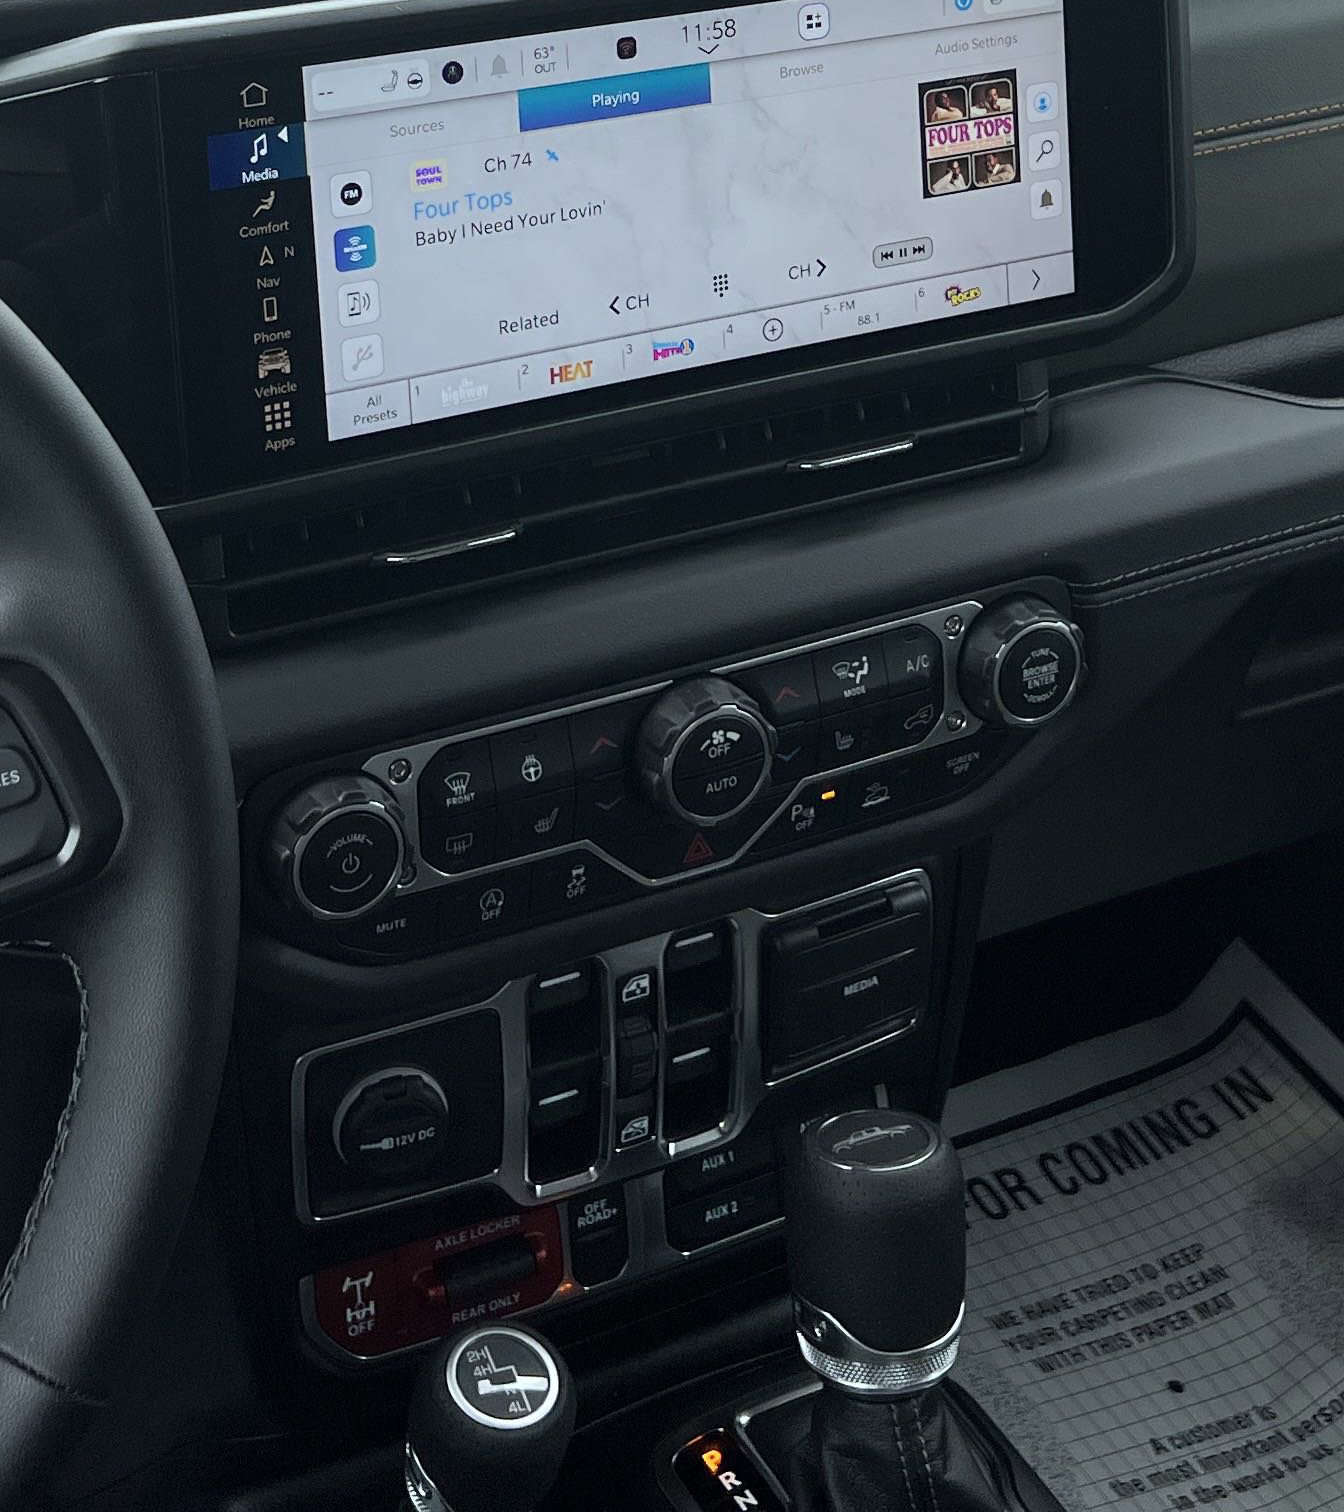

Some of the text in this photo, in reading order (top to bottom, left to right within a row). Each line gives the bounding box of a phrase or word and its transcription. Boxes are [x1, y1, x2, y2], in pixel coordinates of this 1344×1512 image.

[681, 18, 737, 43] 11:58
[533, 46, 556, 61] 63°
[935, 32, 1018, 57] Audio Settings
[534, 61, 557, 74] OUT
[779, 61, 825, 79] Browse
[591, 89, 640, 109] Playing
[238, 113, 276, 130] Home
[389, 119, 445, 138] Sources
[927, 115, 1013, 147] FOUR TOPS
[415, 165, 443, 177] SOUL
[484, 152, 532, 174] Ch 74
[242, 167, 279, 184] Media
[416, 174, 443, 186] TOWN
[413, 189, 513, 221] Four Tops
[239, 219, 291, 238] Comfort
[415, 200, 608, 247] Baby Need Your Lovin'
[788, 264, 811, 281] CH
[256, 275, 281, 290] Nav
[626, 294, 650, 311] CH
[839, 300, 856, 313] FM
[498, 310, 561, 335] Related
[857, 313, 881, 327] 88.1
[254, 327, 292, 344] Phone
[550, 360, 594, 384] HEAT
[255, 380, 298, 399] Vehicle
[366, 394, 382, 409] All
[353, 407, 398, 427] Presets
[265, 435, 296, 453] Apps
[906, 653, 930, 674] A/C
[1022, 661, 1059, 679] BROWSE
[1027, 673, 1056, 689] ENTER
[843, 685, 867, 699] MODE
[708, 742, 731, 759] OFF
[946, 750, 980, 769] SCREEN
[953, 762, 971, 776] OFF
[705, 775, 738, 794] AUTO
[446, 791, 475, 807] FRONT
[795, 816, 814, 831] OFF
[330, 833, 368, 853] VOLUME
[566, 885, 587, 899] OFF
[481, 908, 502, 921] OFF
[376, 918, 408, 935] MUTE
[843, 976, 879, 996] MEDIA
[394, 1126, 435, 1148] 12V DC
[1037, 1065, 1274, 1196] COMING IN
[701, 1154, 724, 1172] AUX
[584, 1199, 607, 1215] OFF
[705, 1205, 728, 1223] AUX
[434, 1215, 520, 1250] AXLE LOCKER
[1130, 1263, 1159, 1285] TO
[1159, 1243, 1206, 1273] KEEP
[1164, 1264, 1231, 1300] CLEAN
[452, 1292, 521, 1324] REAR ONLY
[1131, 1310, 1196, 1344] PAPER
[1194, 1291, 1237, 1321] MAT
[347, 1320, 376, 1337] OFF
[466, 1348, 485, 1363] 2H
[473, 1362, 493, 1377] 4H
[507, 1399, 527, 1414] 4L
[701, 1449, 722, 1475] P
[1109, 1477, 1145, 1497] the
[1193, 1429, 1294, 1472] important
[718, 1470, 742, 1492] R
[733, 1491, 759, 1512] N
